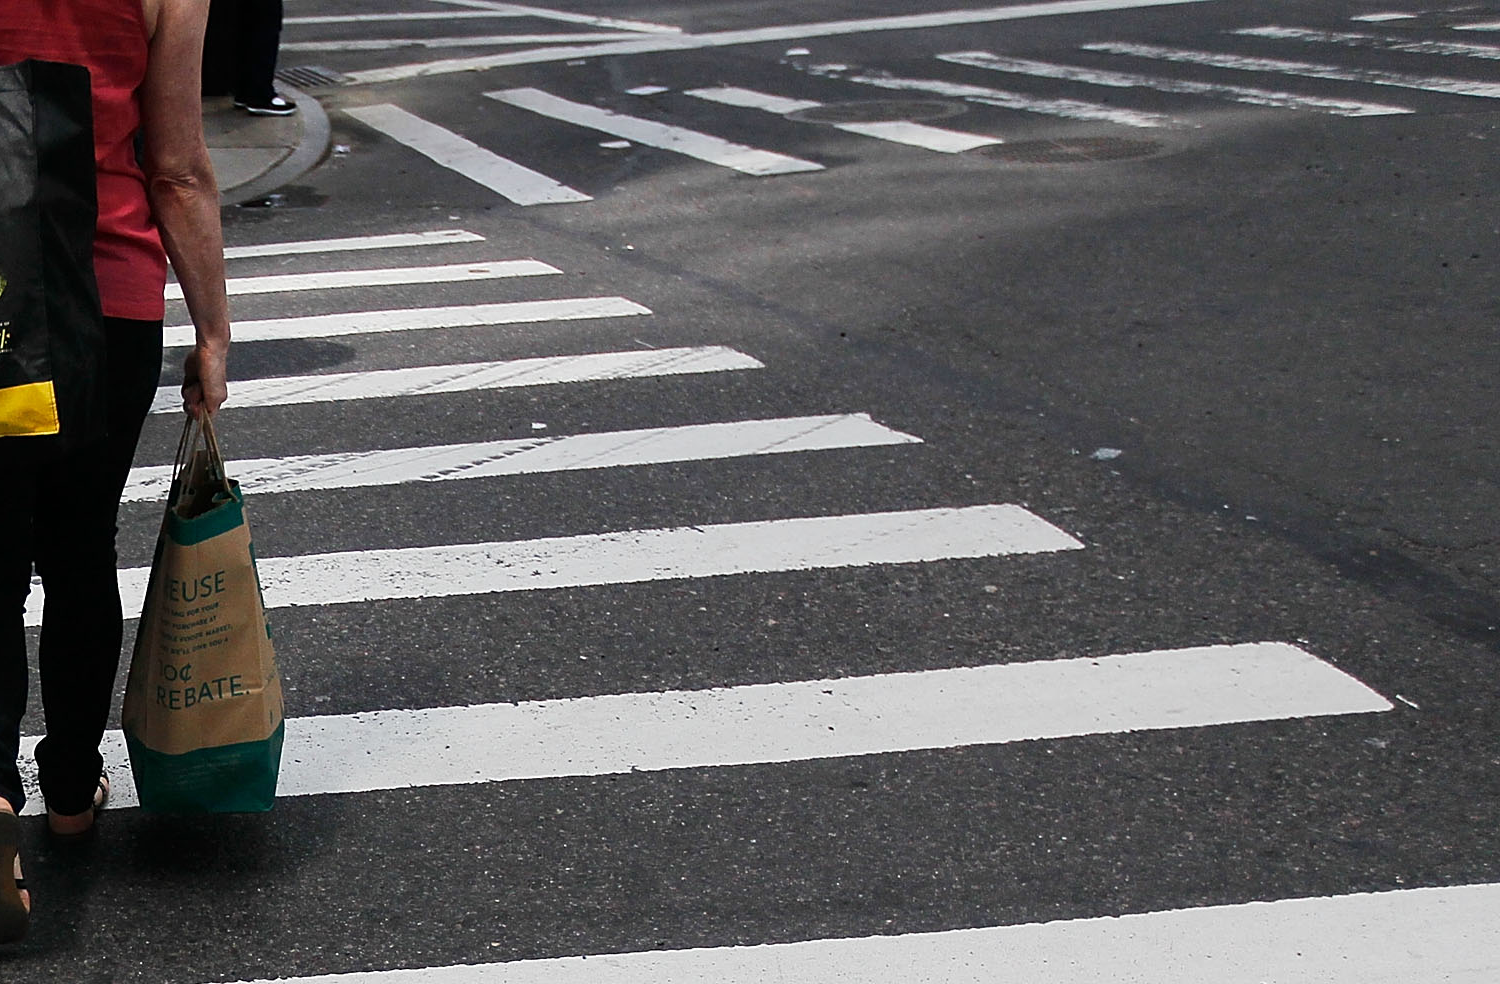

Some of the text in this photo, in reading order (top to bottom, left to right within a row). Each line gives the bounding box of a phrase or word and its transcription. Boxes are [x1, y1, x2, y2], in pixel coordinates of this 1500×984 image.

[186, 607, 200, 617] FOR
[201, 602, 219, 613] YOUR
[172, 618, 208, 631] PURCHASE
[208, 615, 217, 623] AT
[208, 639, 223, 648] YOU
[156, 675, 250, 710] REBATE.
